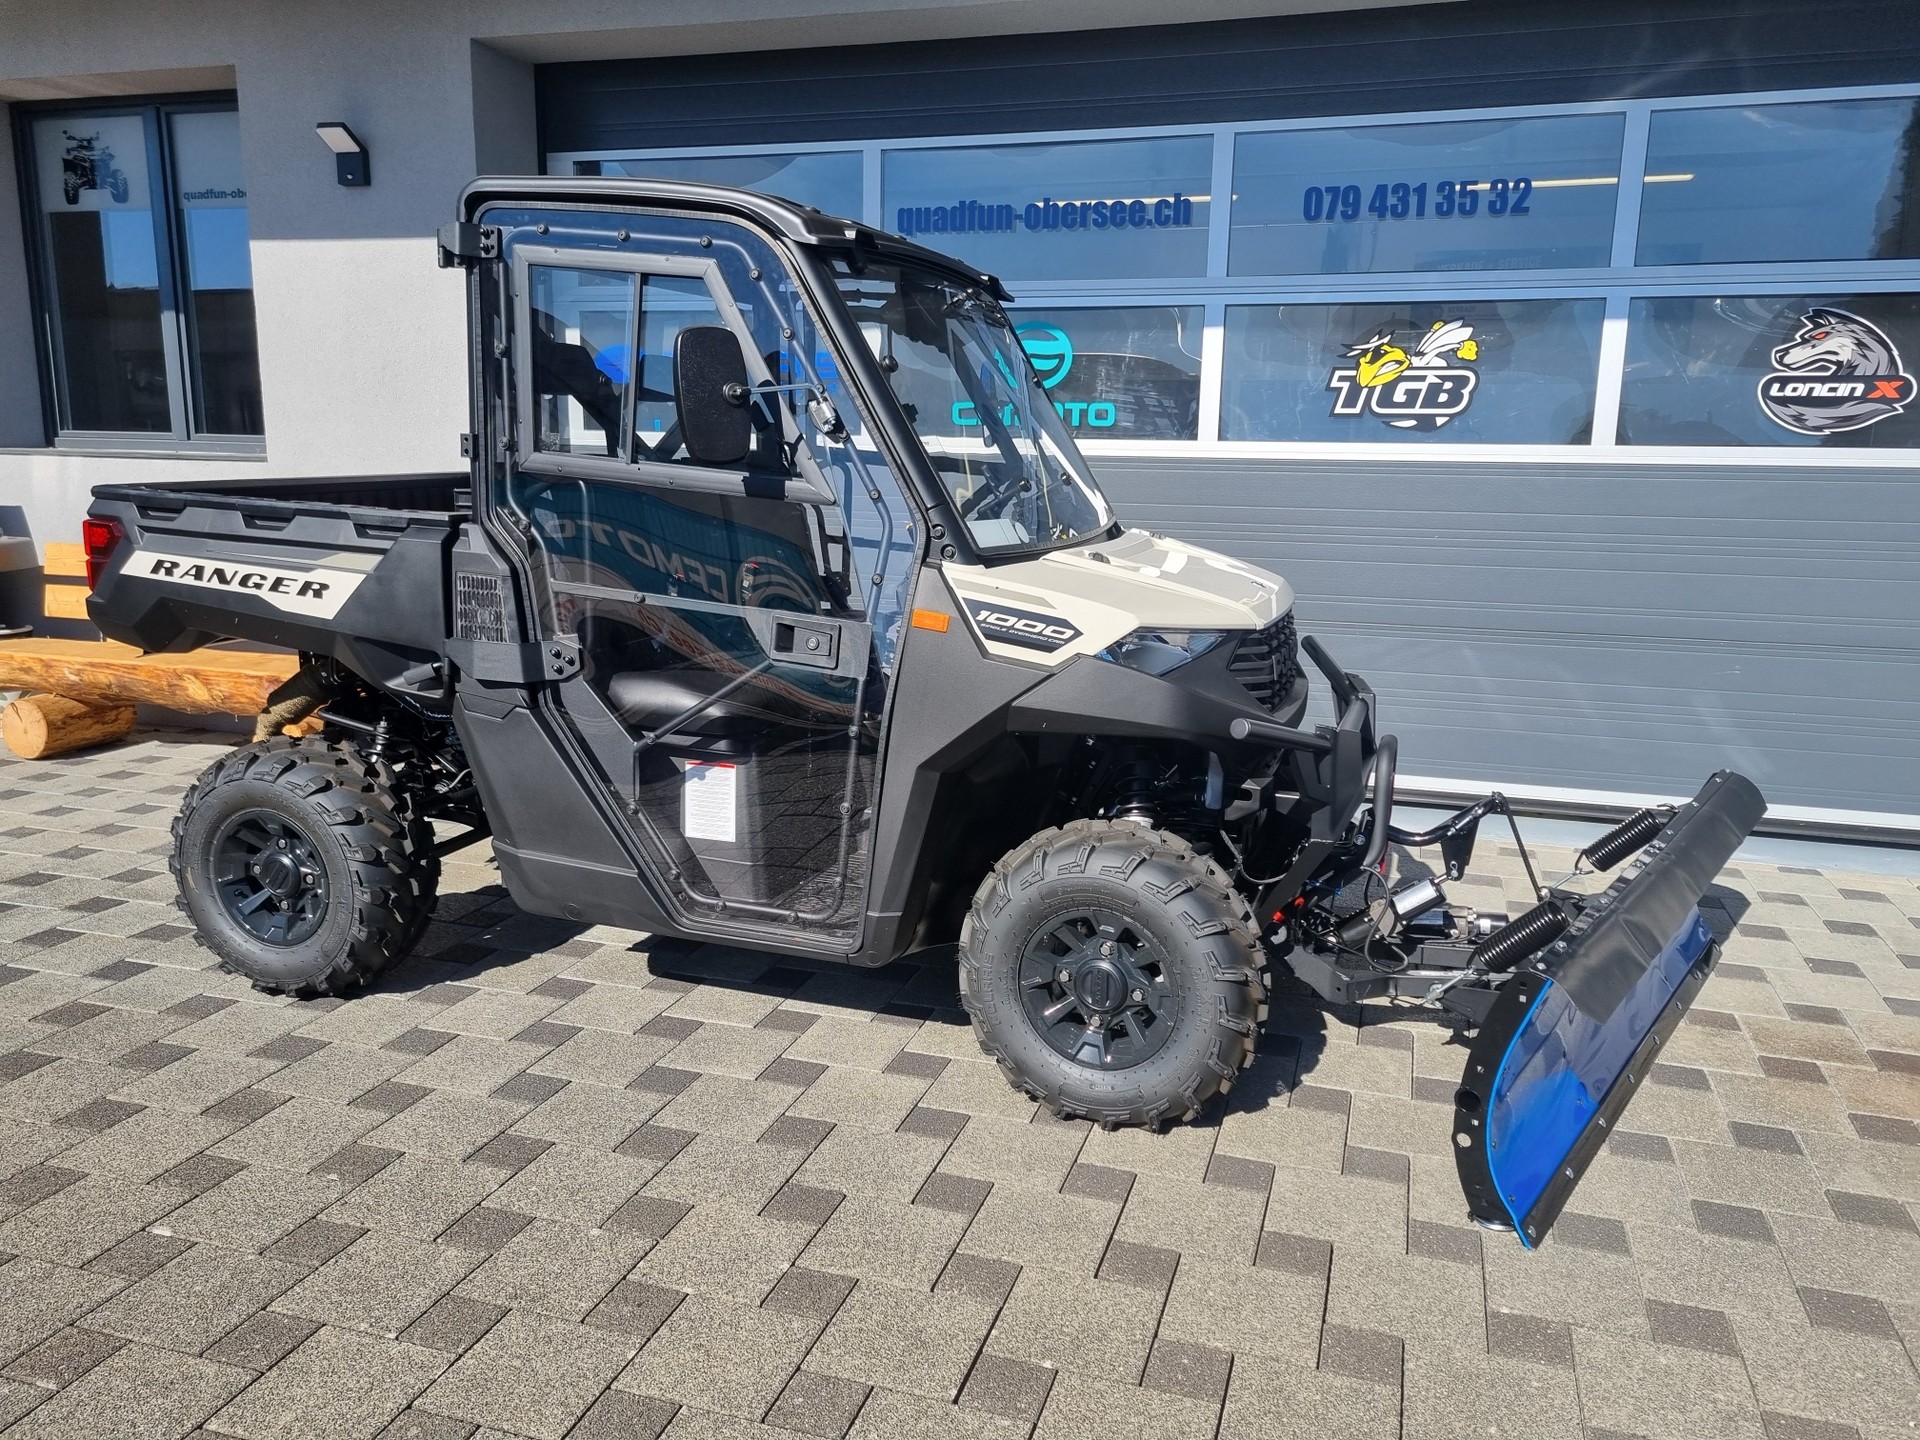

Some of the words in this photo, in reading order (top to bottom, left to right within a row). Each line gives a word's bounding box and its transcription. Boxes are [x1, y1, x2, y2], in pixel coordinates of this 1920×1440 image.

[896, 193, 1192, 236] quadfun-obersee.ch
[1303, 185, 1362, 222] 079
[1368, 182, 1428, 220] 431
[1435, 180, 1480, 217] 35
[1488, 177, 1533, 216] 32
[1329, 368, 1477, 415] TGB
[1866, 381, 1905, 399] X
[150, 558, 331, 600] RANGER
[975, 610, 1075, 640] 1000
